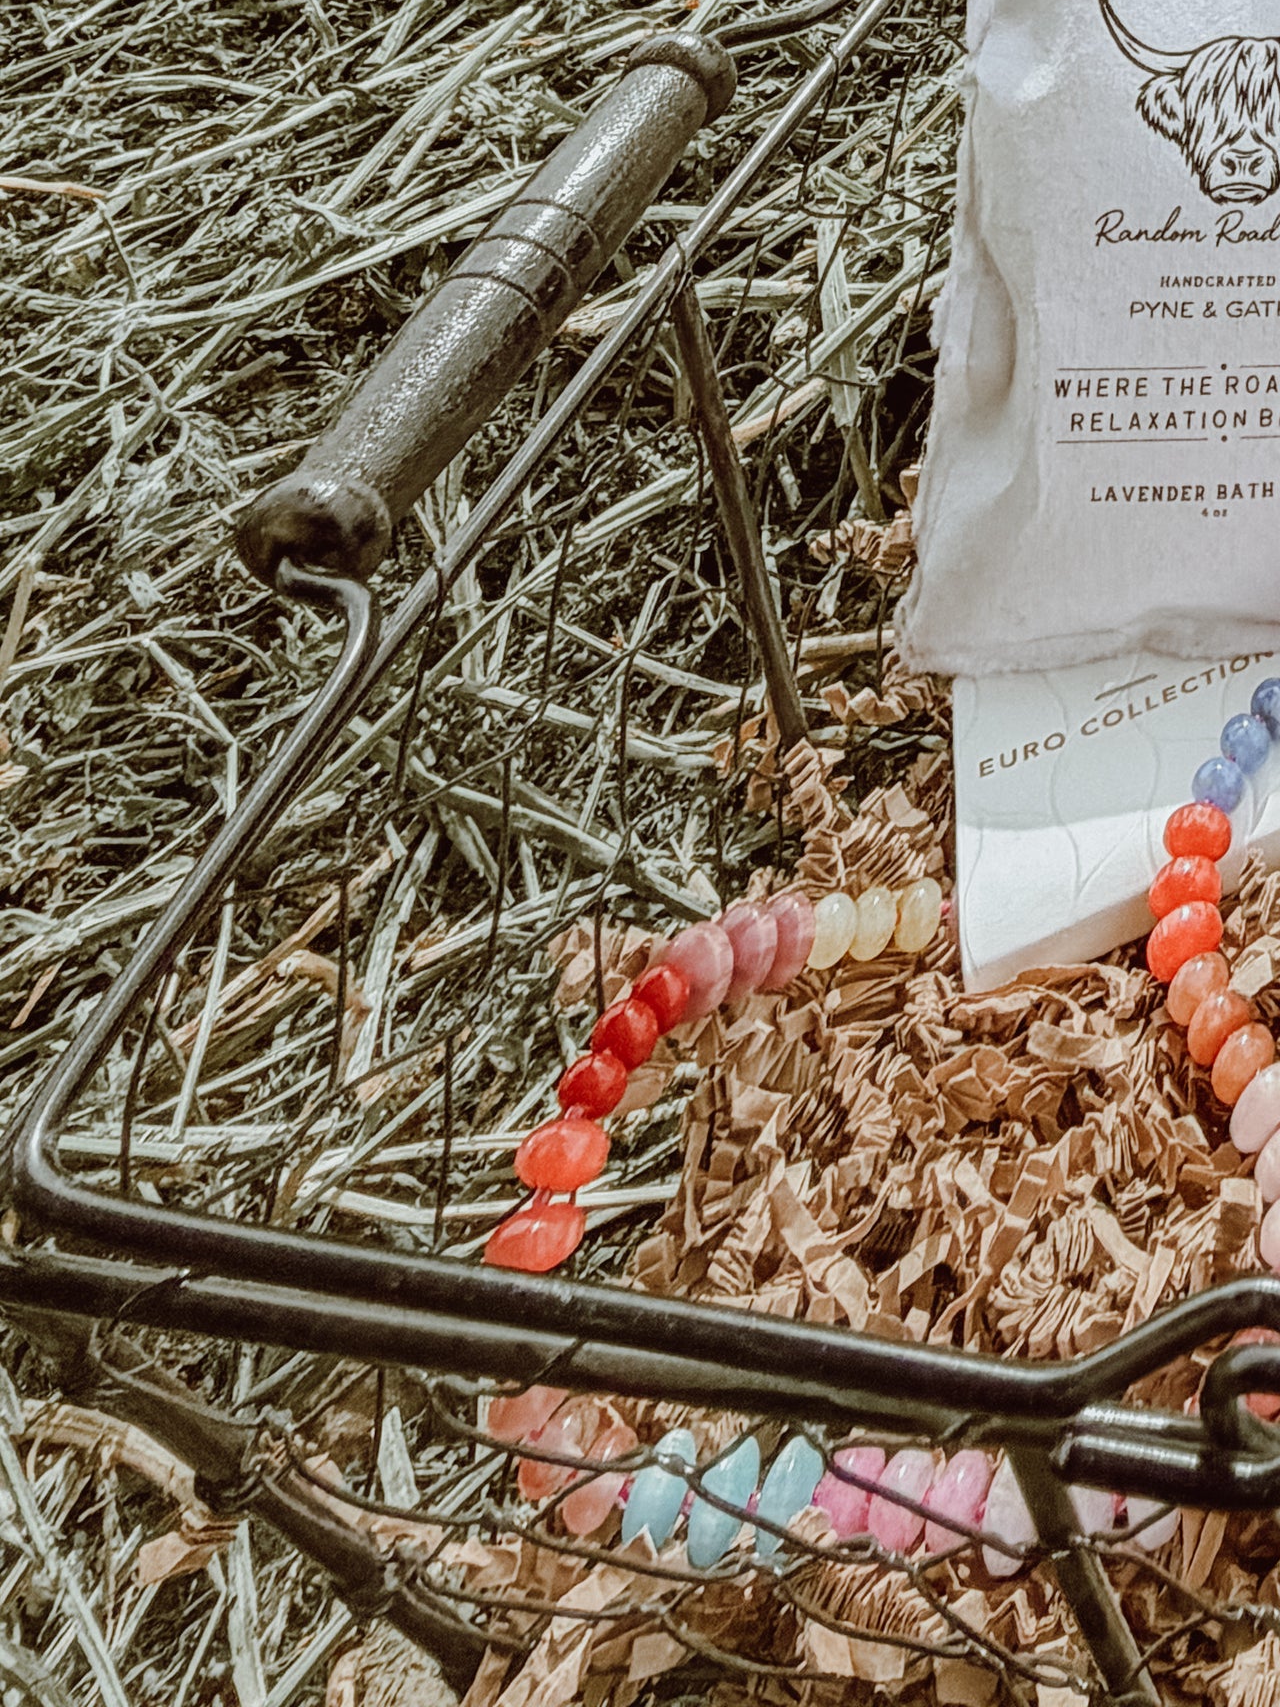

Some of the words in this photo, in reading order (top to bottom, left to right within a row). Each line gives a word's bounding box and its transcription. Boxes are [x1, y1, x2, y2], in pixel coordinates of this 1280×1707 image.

[1095, 206, 1207, 247] Random
[1160, 275, 1276, 288] HANDCRAFTED
[1129, 301, 1195, 318] PYNE
[1202, 301, 1217, 318] &
[1054, 376, 1149, 399] WHERE
[1162, 375, 1213, 396] THE
[1070, 408, 1248, 433] RELAXATION
[1090, 485, 1206, 503] LAVENDER
[1216, 482, 1275, 500] BATH
[977, 732, 1066, 778] EURO
